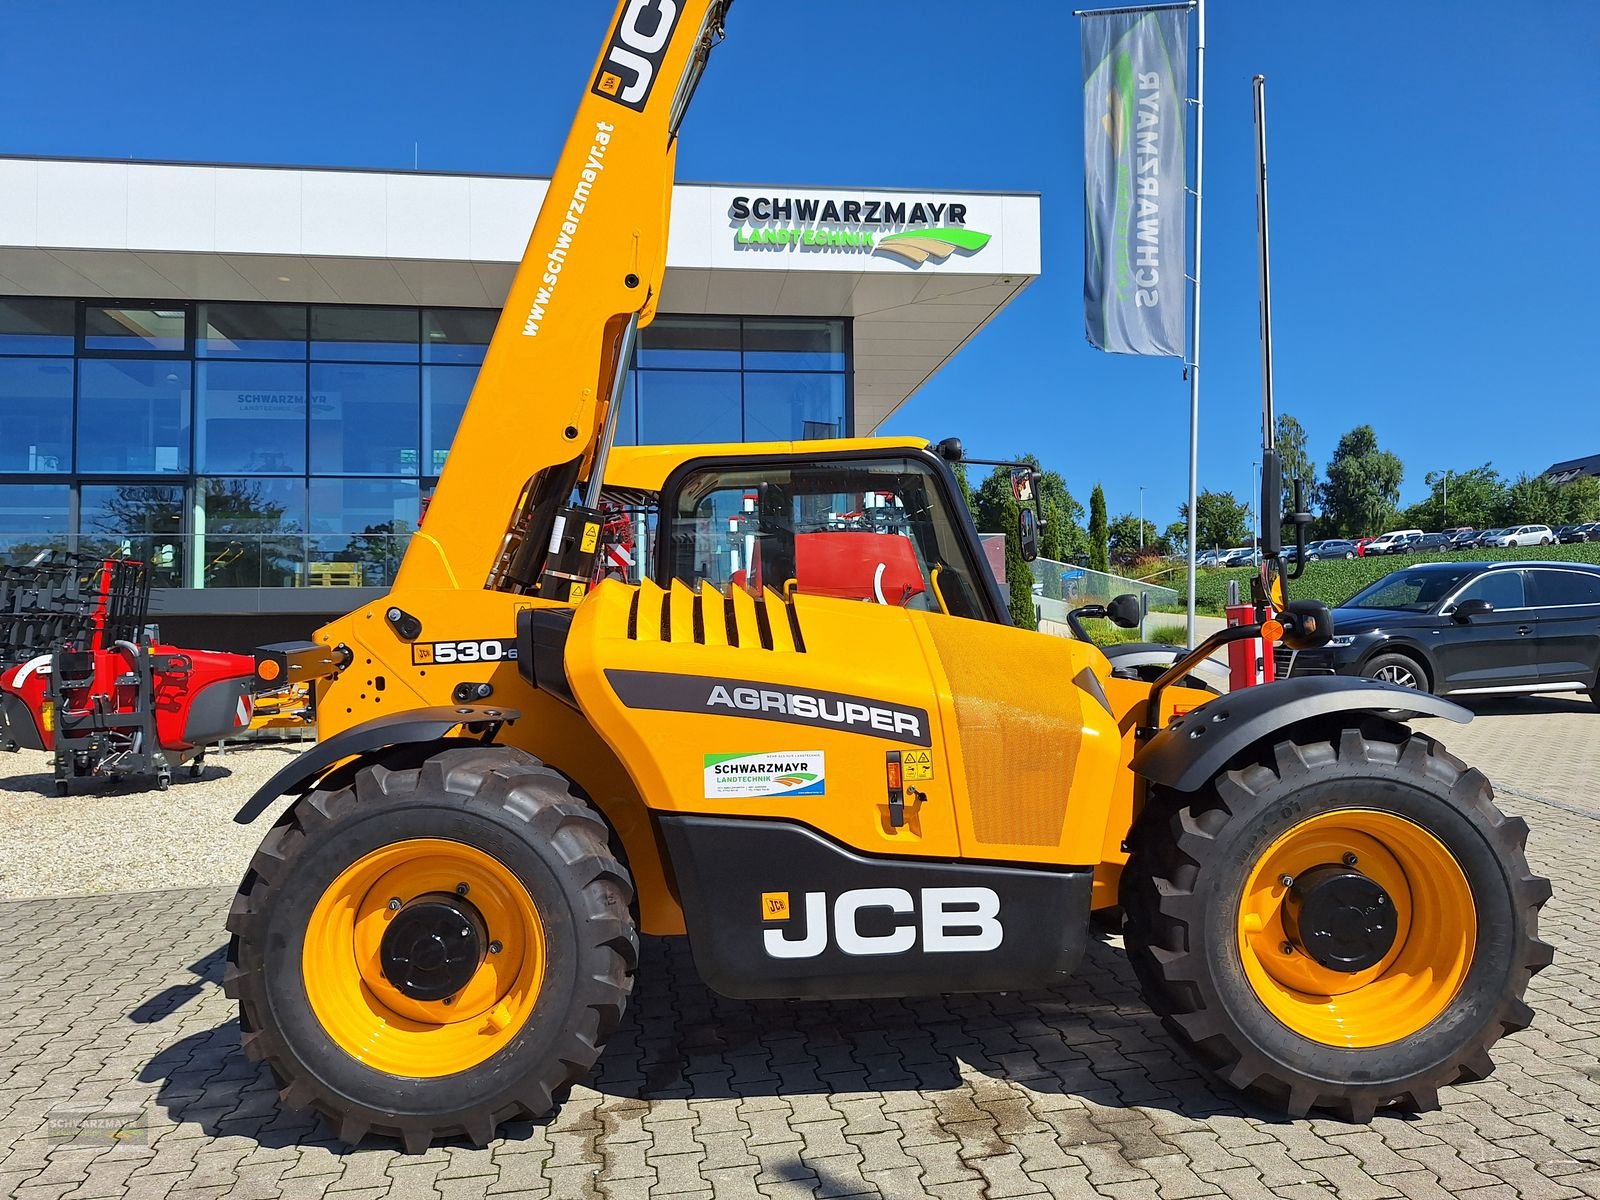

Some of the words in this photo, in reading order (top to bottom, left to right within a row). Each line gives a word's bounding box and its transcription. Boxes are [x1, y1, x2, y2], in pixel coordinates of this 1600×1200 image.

[609, 0, 677, 103] JC
[731, 195, 968, 225] SCHWARZMAYR
[521, 120, 615, 338] www.schwarzmayr.at
[736, 227, 876, 247] LANDTECHNIK
[237, 393, 327, 404] SCHWARZMYR
[434, 640, 518, 663] 530-6
[714, 762, 809, 775] SCHWARZMAYR
[716, 776, 772, 784] LANDTECHNIK
[769, 899, 786, 913] JCB
[763, 886, 1004, 959] JCB
